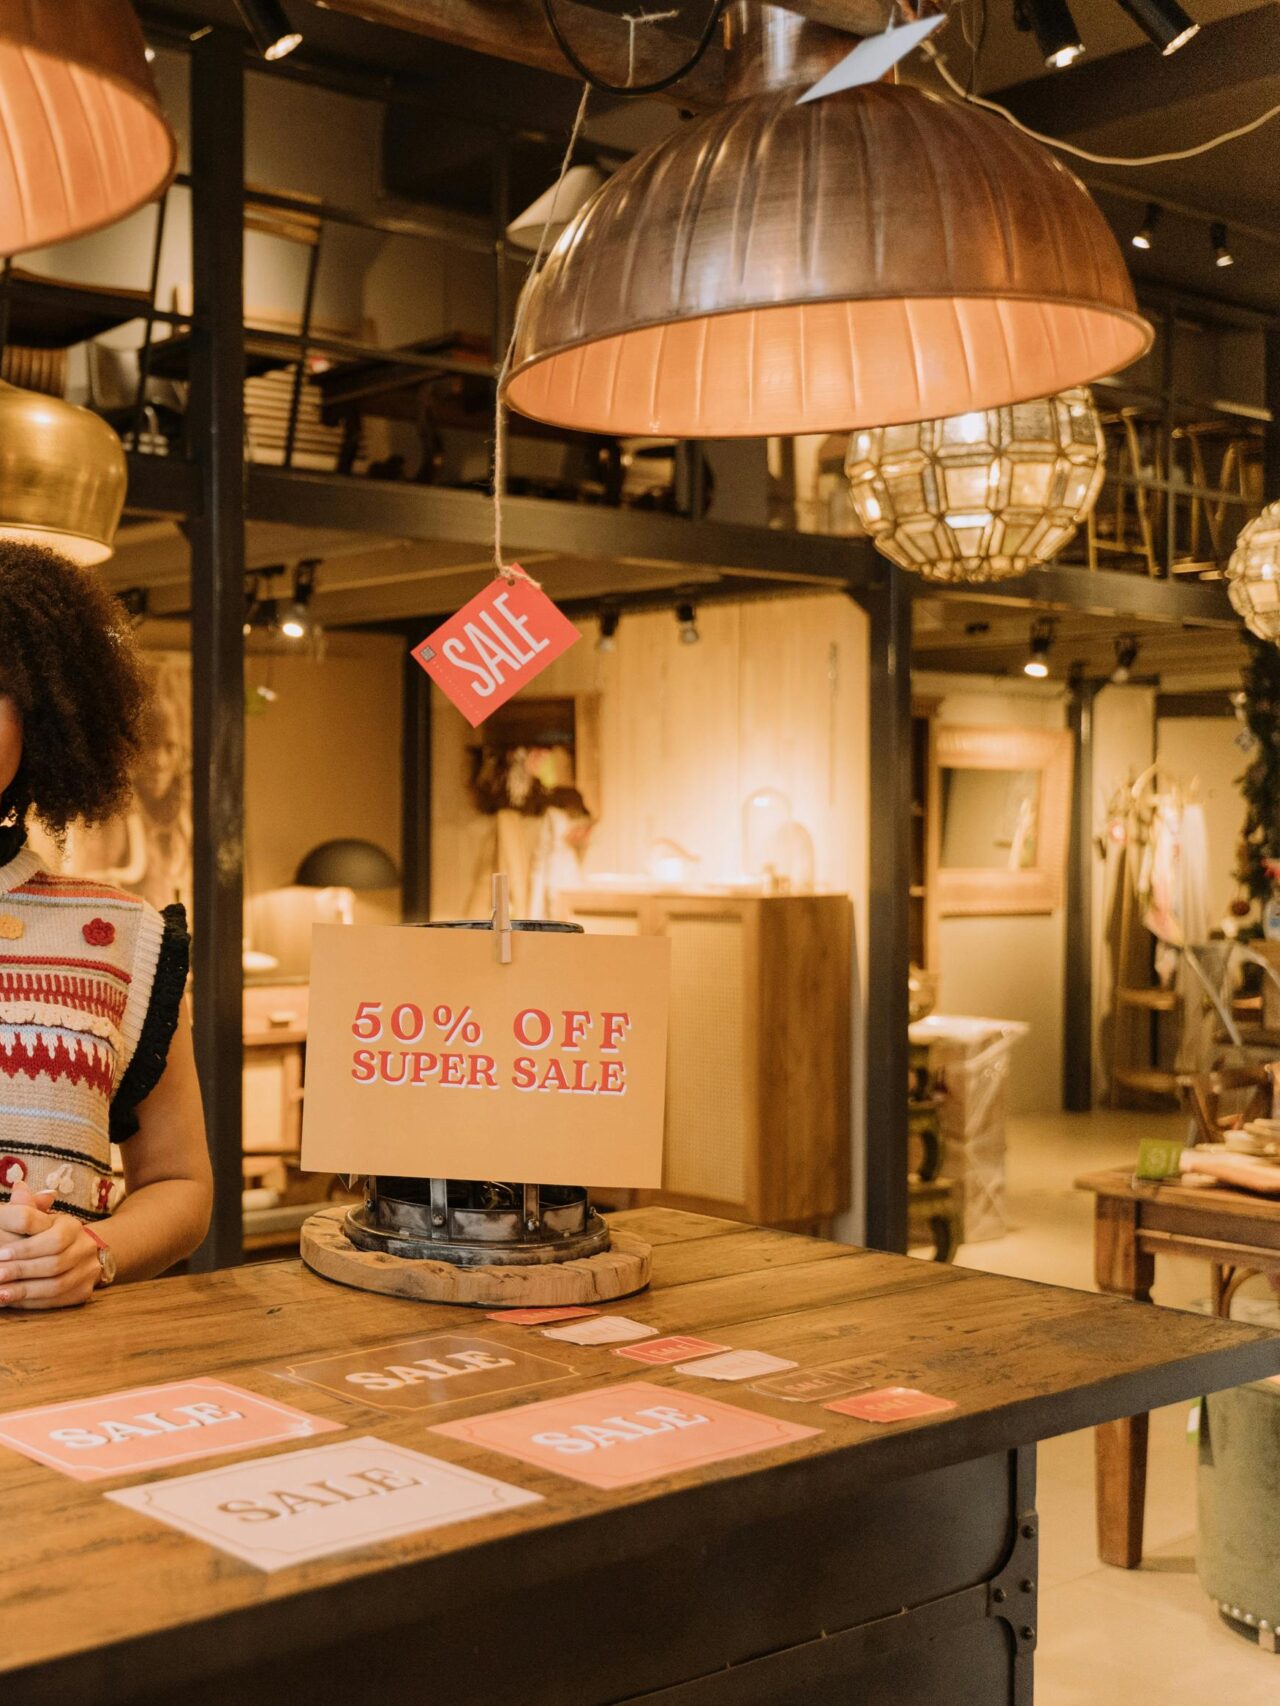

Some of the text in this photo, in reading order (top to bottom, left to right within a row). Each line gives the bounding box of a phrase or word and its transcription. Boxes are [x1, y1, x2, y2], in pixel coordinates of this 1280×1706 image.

[442, 592, 550, 697] SALE
[351, 1001, 631, 1054] 50% OFF
[351, 1049, 627, 1095] SUPER SALE
[345, 1349, 517, 1391] SALE
[48, 1401, 246, 1449] SALE
[531, 1405, 711, 1455] SALE
[216, 1466, 429, 1524] SALE
